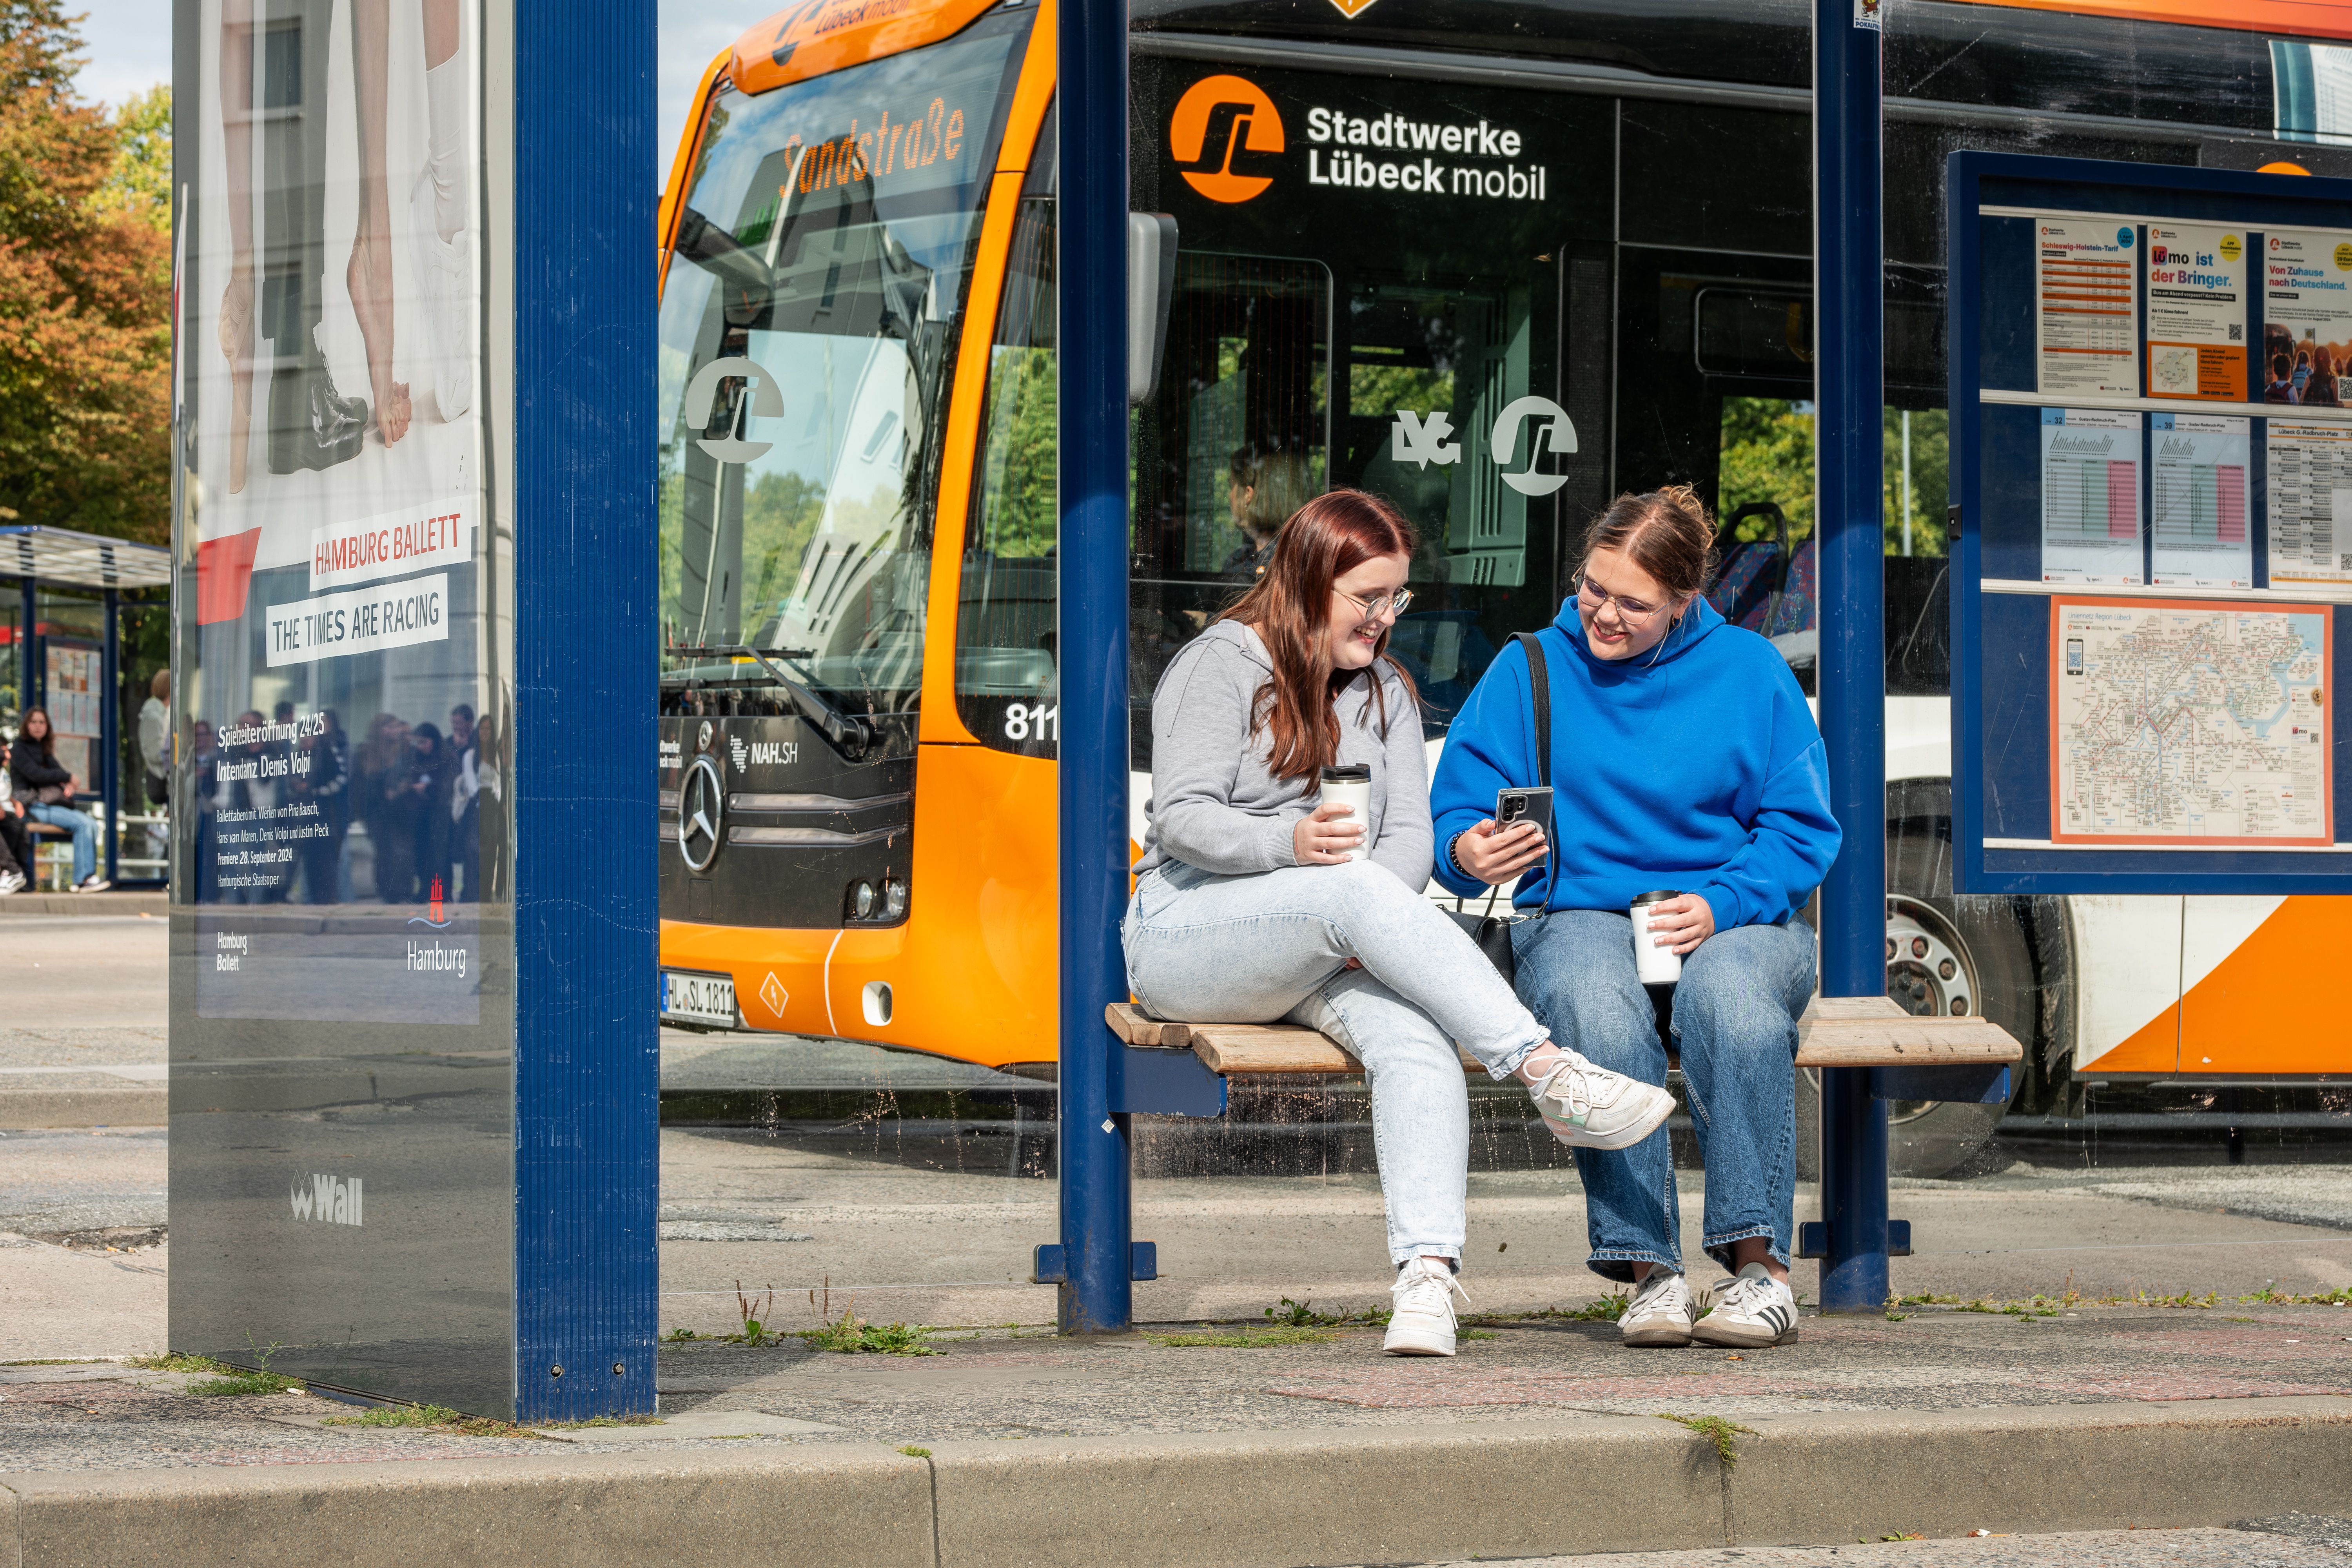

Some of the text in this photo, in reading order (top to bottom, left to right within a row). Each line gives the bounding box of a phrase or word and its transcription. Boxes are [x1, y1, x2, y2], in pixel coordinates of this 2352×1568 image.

[814, 1, 870, 35] Lübeck
[1308, 107, 1521, 156] Stadtwerke
[779, 97, 964, 199] Sandstraße
[1309, 149, 1545, 200] Lübeck mobil
[2042, 242, 2118, 252] Schleswig-Holstein-Tarif
[2154, 250, 2213, 267] lümo ist
[2152, 269, 2232, 289] der Bringer.
[2269, 265, 2324, 277] Von Zuhause
[2269, 278, 2347, 290] nach Deutschland.
[316, 513, 461, 575] HAMBURG BALLETT
[272, 592, 439, 652] THE TIMES ARE RACING
[2095, 613, 2112, 621] Region
[218, 712, 324, 752] Spielzeiteröffnung 24/25
[751, 742, 798, 764] NAH.SH
[217, 750, 310, 782] Intendanz Demis Volpi
[217, 808, 248, 822] Ballettabend
[258, 805, 276, 819] Werken
[278, 807, 287, 818] von
[289, 803, 299, 817] Pina
[299, 801, 319, 816] Bausch,
[217, 823, 329, 844] Hans van Manen, Demis Volpi und Justin Peck
[218, 848, 292, 867] Premiere 28. September 2024
[218, 873, 279, 889] Hamburgische Staatsoper
[218, 931, 247, 956] Hamburg
[217, 953, 239, 971] Ballett
[408, 941, 466, 978] Hamburg
[668, 978, 734, 1015] HL SL 1811
[314, 1174, 362, 1226] Wall
